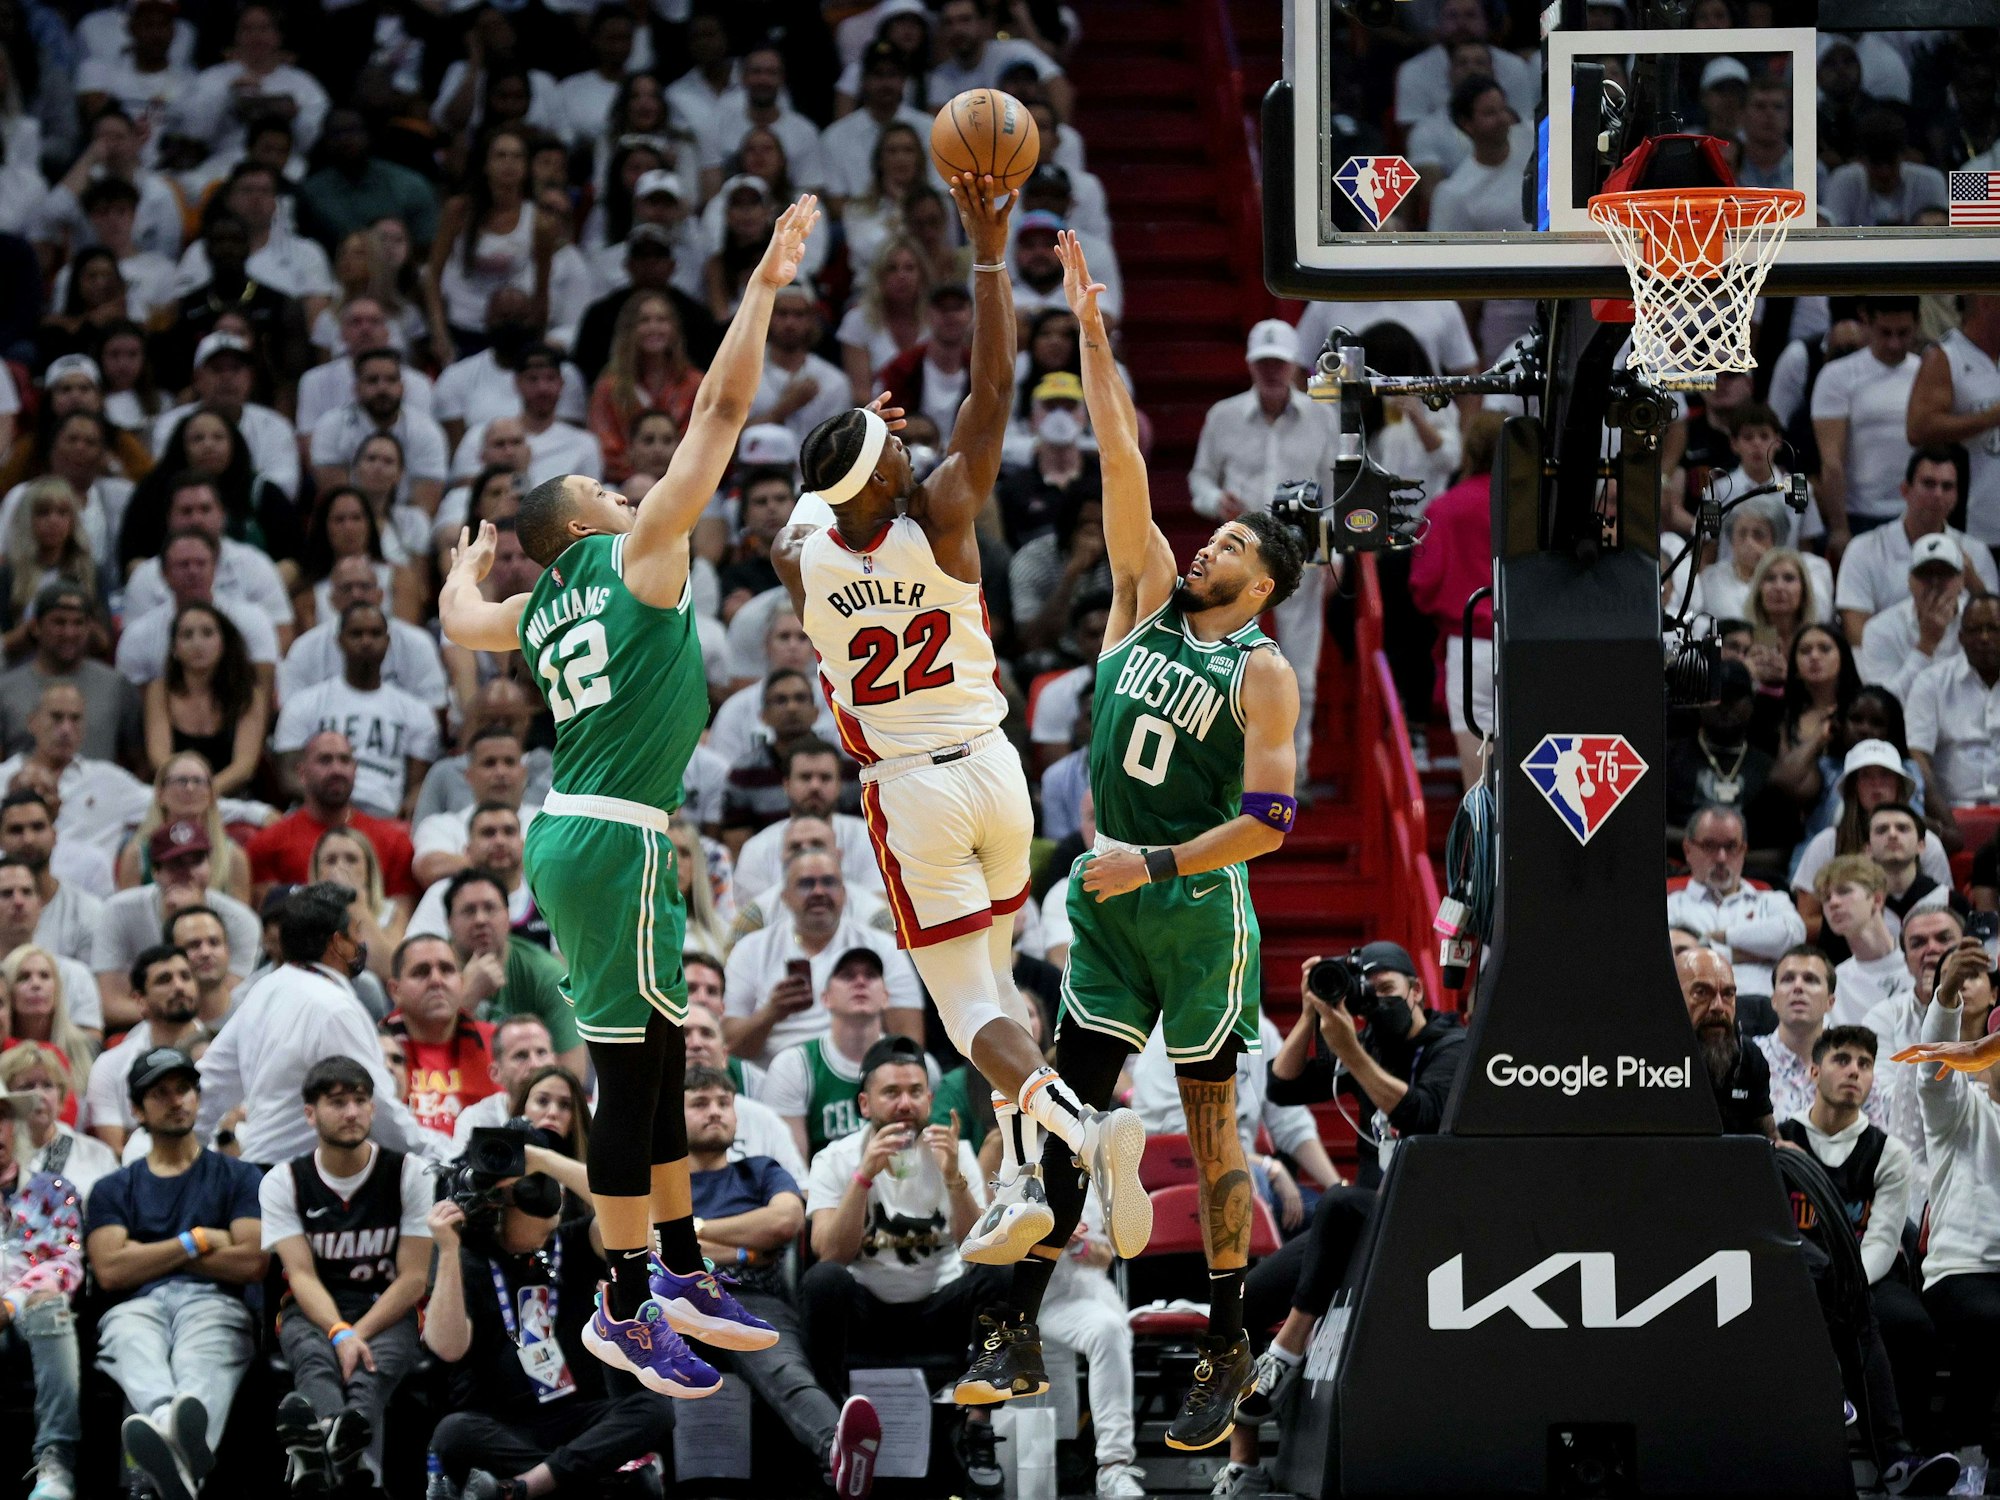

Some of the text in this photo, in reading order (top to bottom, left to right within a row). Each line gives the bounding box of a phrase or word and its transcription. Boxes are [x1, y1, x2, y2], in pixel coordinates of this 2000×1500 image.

[1384, 166, 1401, 189] 75
[525, 586, 610, 650] WILLIAMS
[827, 580, 926, 618] BUTLER
[538, 619, 612, 723] 12
[848, 608, 955, 707] 22
[1206, 663, 1233, 677] PRINT
[1209, 655, 1235, 668] VISTA
[1114, 644, 1225, 742] BOSTON
[1122, 713, 1177, 787] 0
[1595, 750, 1619, 783] 75
[1268, 801, 1293, 824] 24
[1486, 1053, 1691, 1096] Google Pixel
[1427, 1250, 1752, 1330] KIA
